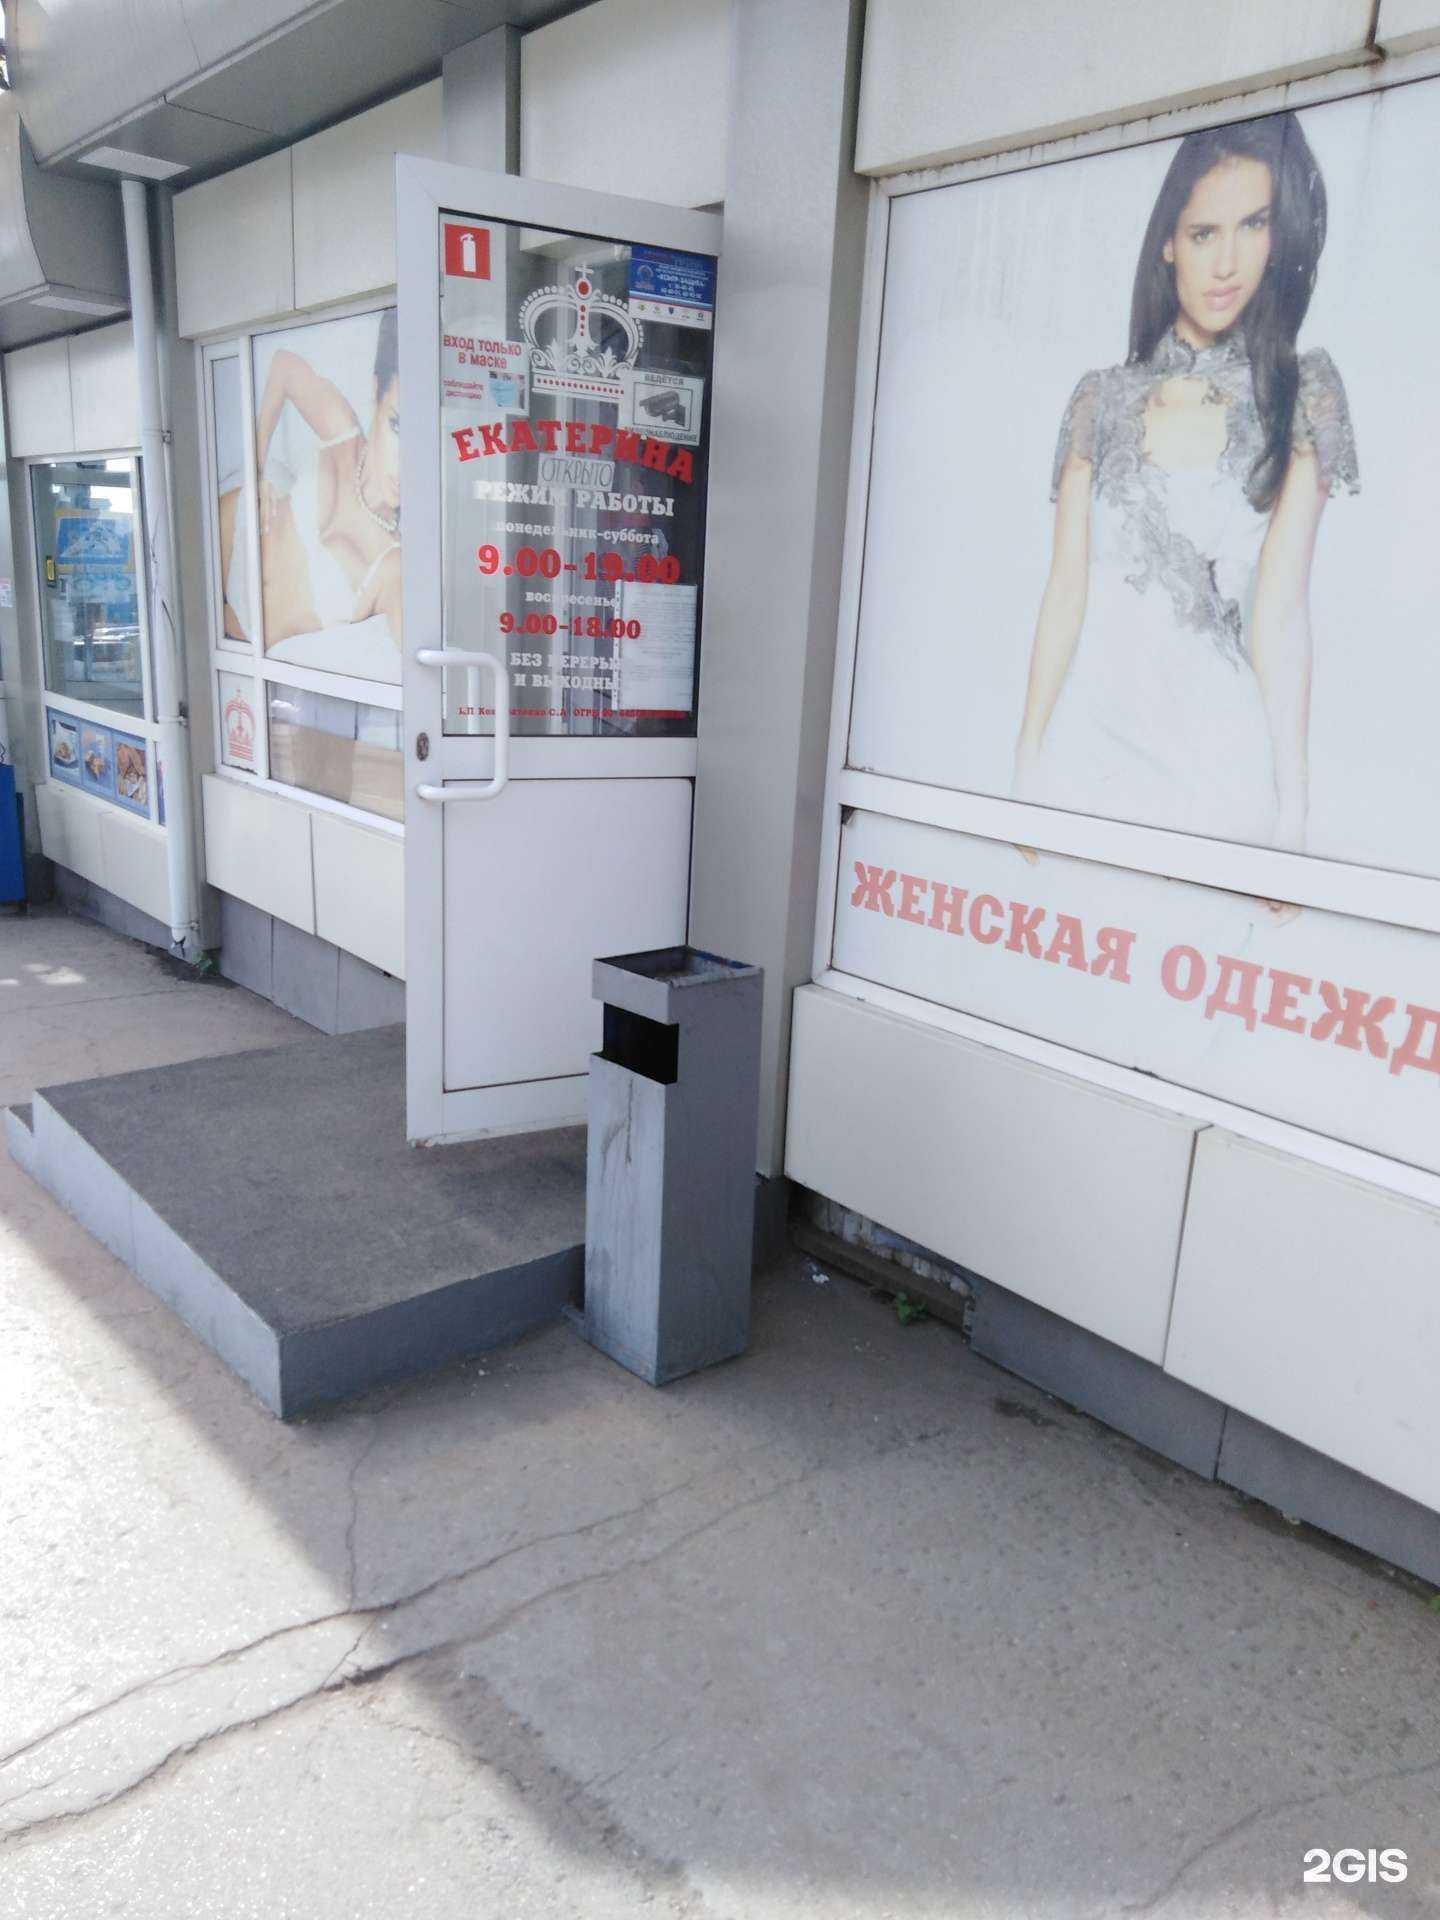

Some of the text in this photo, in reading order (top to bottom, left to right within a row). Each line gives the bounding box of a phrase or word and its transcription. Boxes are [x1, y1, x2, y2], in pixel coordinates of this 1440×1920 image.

[451, 419, 694, 485] ЕКАТЕРИНА
[541, 458, 614, 488] ОТКРЫТО
[473, 480, 675, 517] РЕЖИМ РАБОТЫ
[477, 544, 681, 585] 9.00-19.00
[525, 591, 618, 610] восресенье
[499, 612, 642, 640] 9.00-18.00
[510, 652, 543, 667] БЕЗ
[513, 673, 527, 687] И
[850, 861, 1137, 984] ЖЕНСКАЯ
